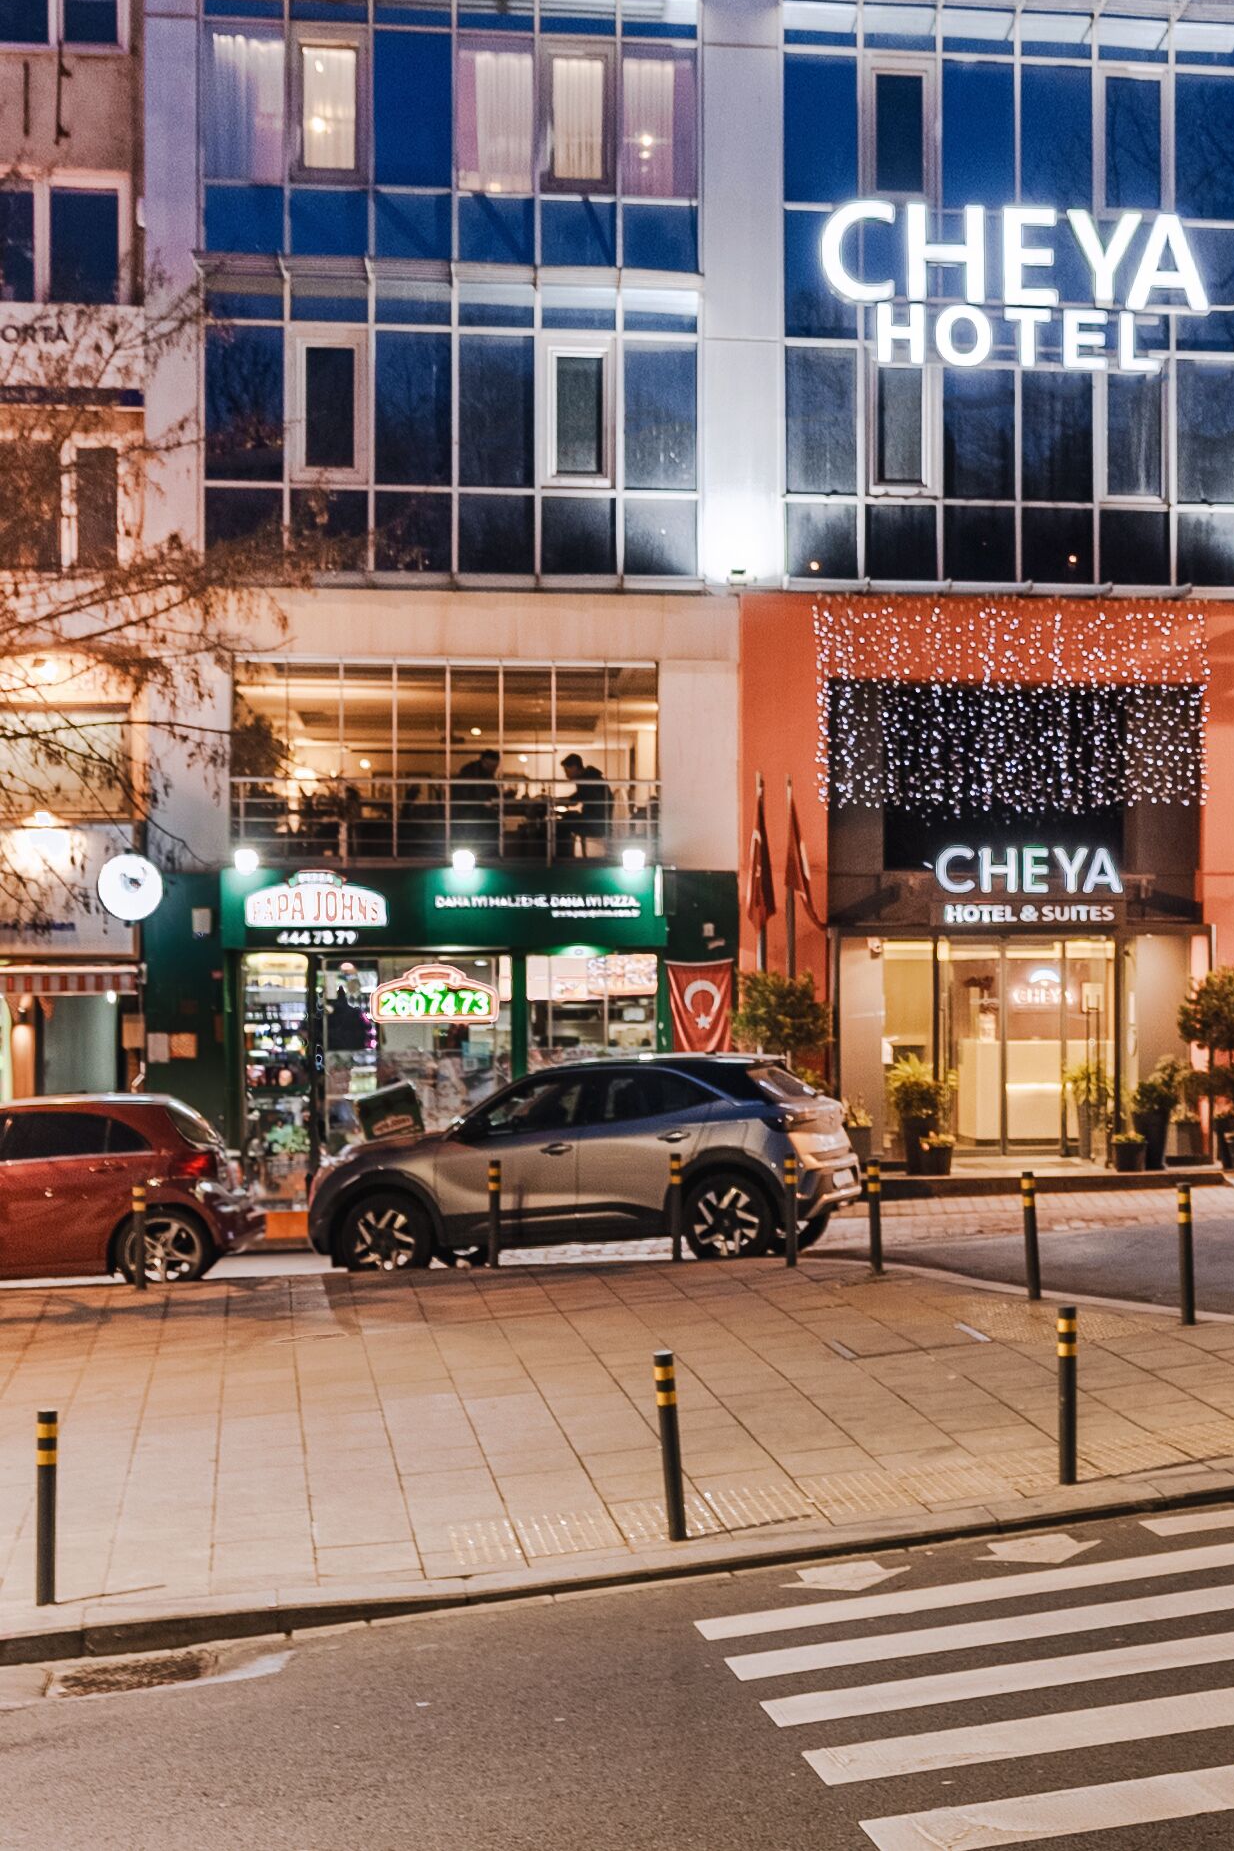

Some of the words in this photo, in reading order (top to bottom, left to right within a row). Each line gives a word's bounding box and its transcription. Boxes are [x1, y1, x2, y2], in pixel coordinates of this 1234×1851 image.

[820, 200, 1209, 313] CHEYA
[876, 302, 1164, 373] HOTEL
[936, 845, 1124, 894] CHEYA
[253, 891, 305, 920] PAPA
[313, 890, 379, 922] JOHNS
[945, 904, 1018, 923] HOTEL
[1020, 904, 1039, 922] &
[1041, 905, 1115, 921] SUITES
